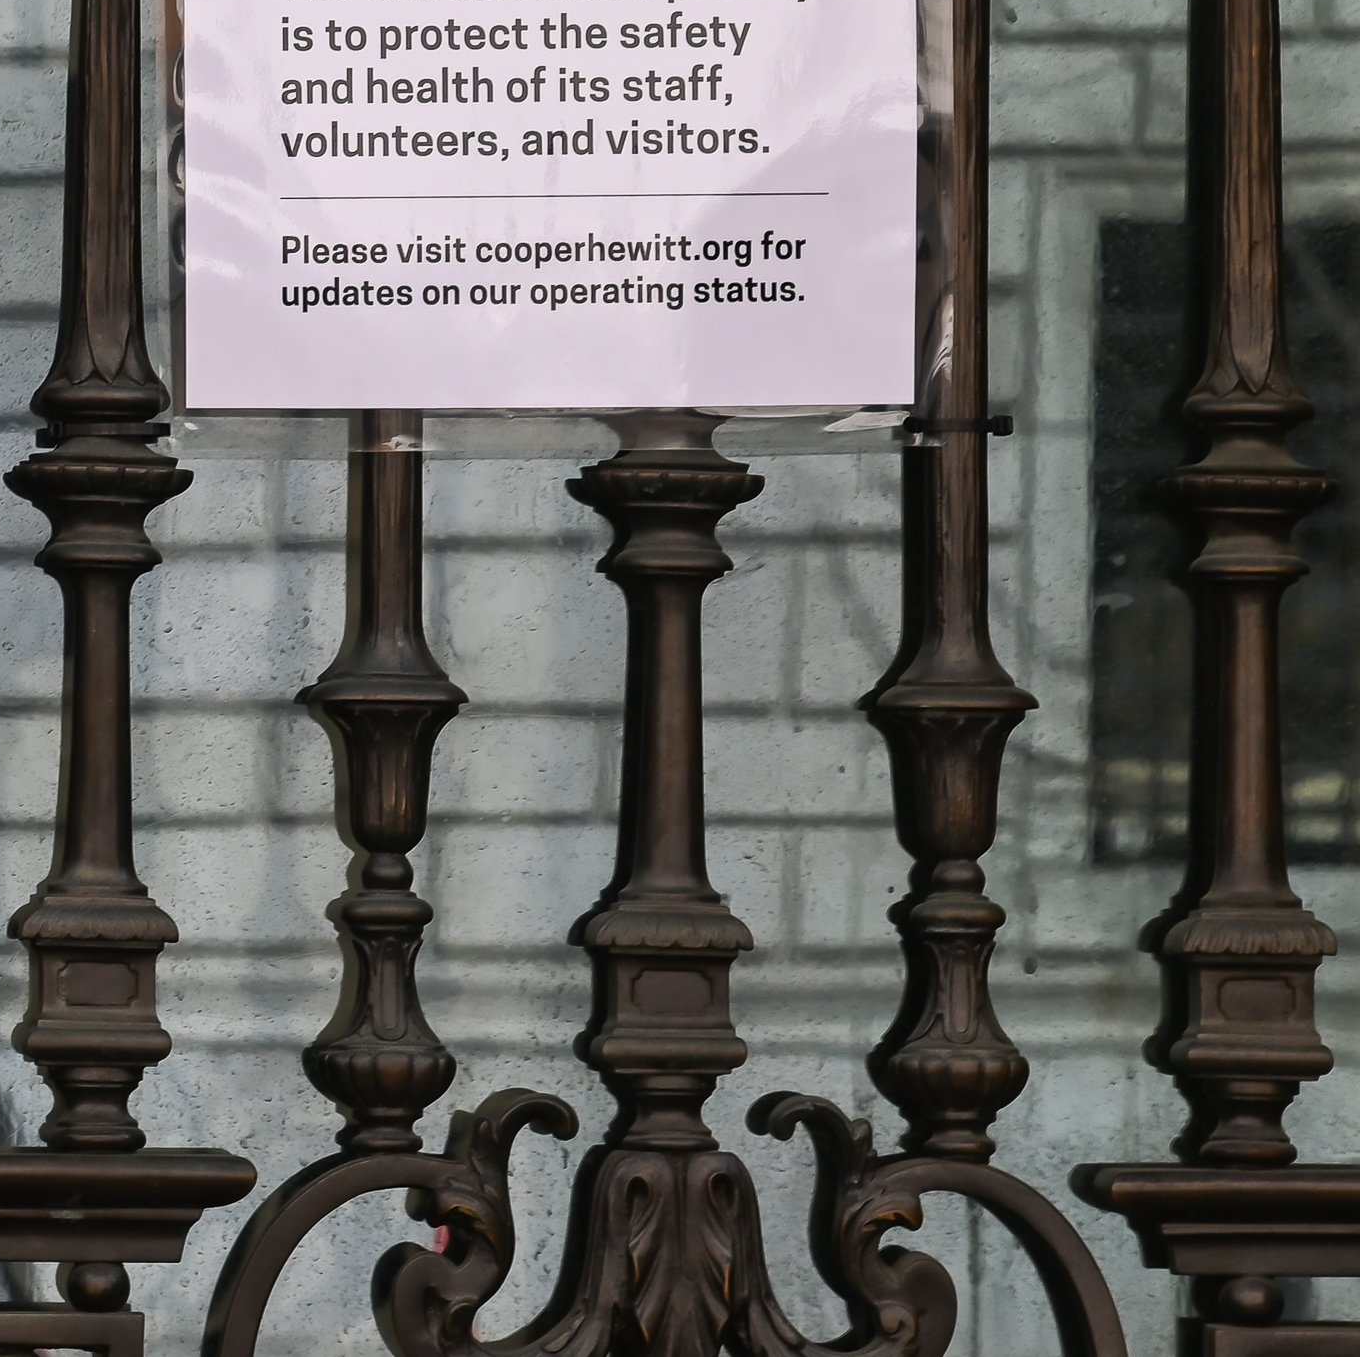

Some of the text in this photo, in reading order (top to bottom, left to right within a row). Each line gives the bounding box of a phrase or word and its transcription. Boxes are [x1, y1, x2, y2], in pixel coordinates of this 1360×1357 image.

[282, 11, 751, 59] is to protect the safety
[282, 64, 732, 106] and health of its staff,
[281, 119, 769, 161] volunteers, and visitors.
[282, 230, 806, 269] Please visit cooperhewitt.org for
[282, 276, 804, 313] updates on our operating status.
